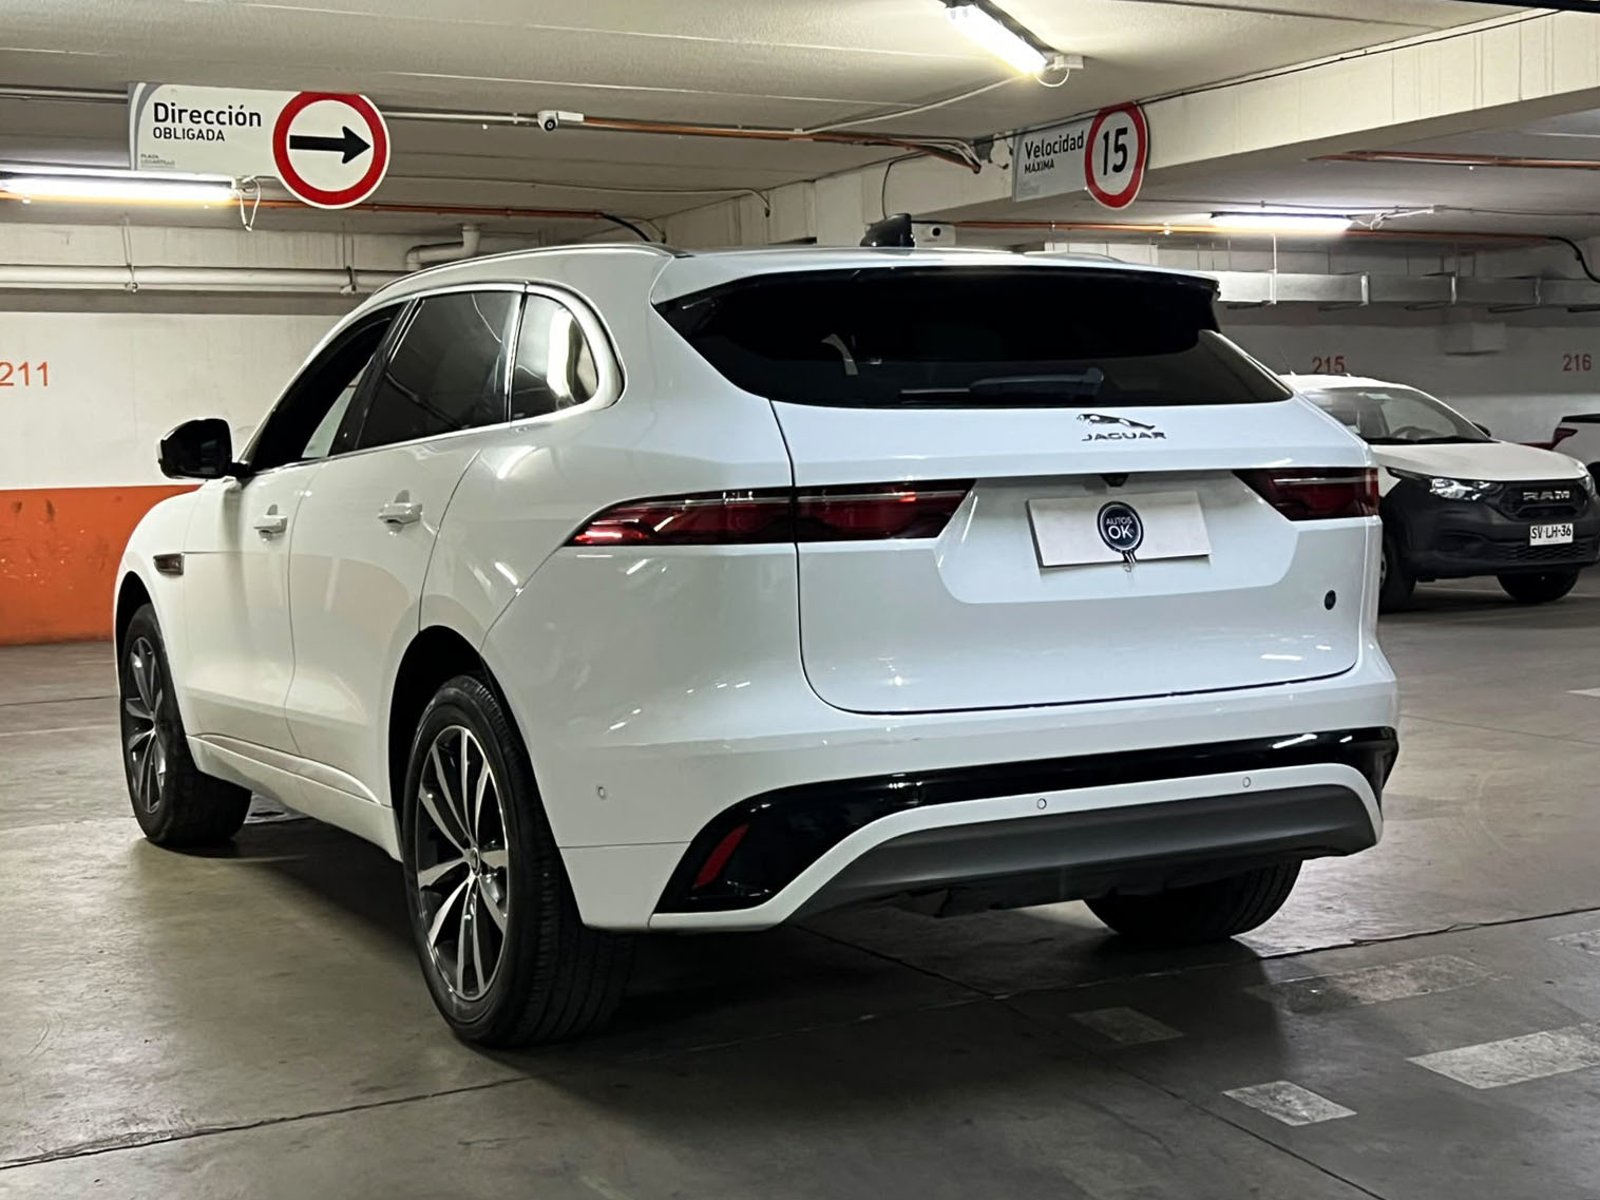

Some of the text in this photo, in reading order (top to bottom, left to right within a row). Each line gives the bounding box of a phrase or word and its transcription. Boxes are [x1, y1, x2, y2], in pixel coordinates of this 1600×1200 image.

[154, 102, 261, 127] Dirección
[153, 127, 225, 141] OBLIGADA
[1025, 130, 1084, 159] Velocidad
[1103, 127, 1128, 176] 15
[1312, 356, 1345, 374] 215
[1562, 354, 1592, 371] 216
[0, 361, 48, 387] 211
[1082, 432, 1166, 441] JAGUAR
[1106, 516, 1133, 525] AUTOS
[1108, 526, 1133, 539] OK
